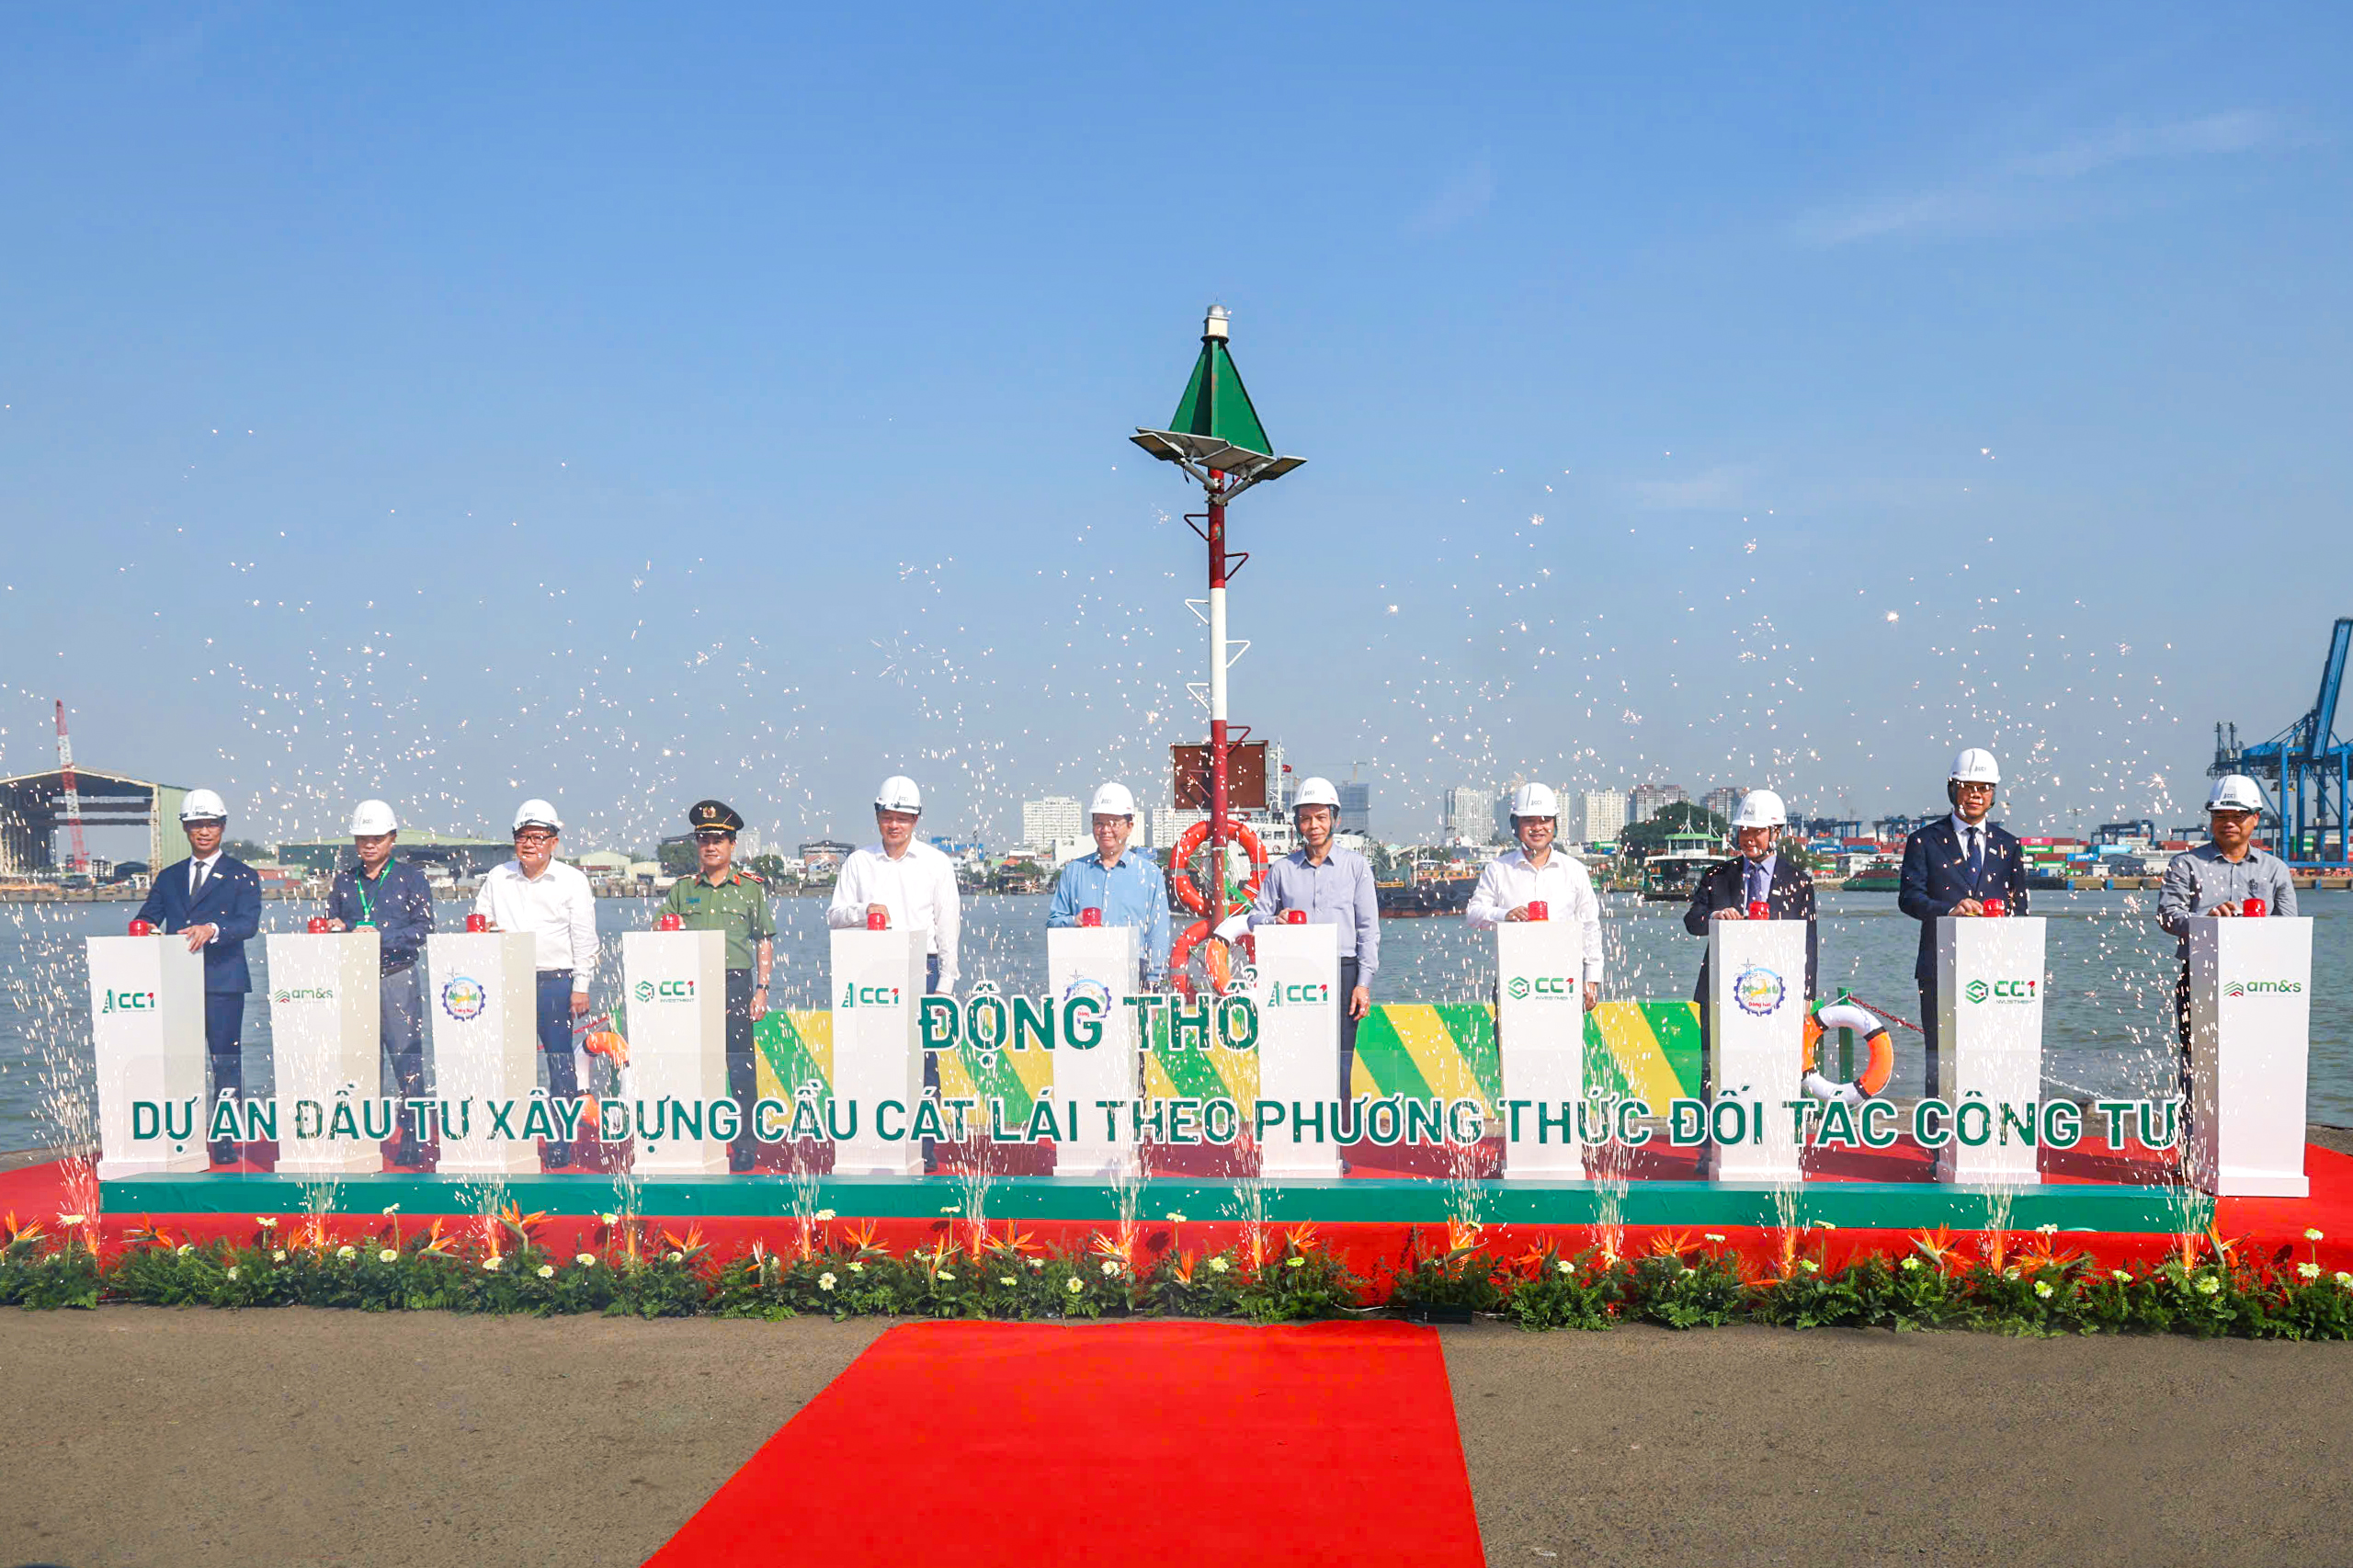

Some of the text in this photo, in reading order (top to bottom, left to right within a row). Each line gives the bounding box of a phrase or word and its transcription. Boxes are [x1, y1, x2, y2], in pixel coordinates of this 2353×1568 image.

[291, 987, 334, 999] am&s
[659, 980, 695, 996] CC1
[1286, 983, 1328, 1002] CC1
[1535, 977, 1574, 994] CC1
[1994, 980, 2036, 997] CC1
[2246, 979, 2302, 993] am&s
[118, 992, 155, 1009] CC1
[859, 986, 899, 1005] CC1
[918, 966, 1259, 1067] ĐỘNG THỔ
[132, 1081, 2185, 1153] DỰ ÁN ĐẦU TƯ XÂY DỰNG CẦU CÁT LÁI THEO PHƯƠNG THỨC ĐỐI TÁC CÔNG TƯ
